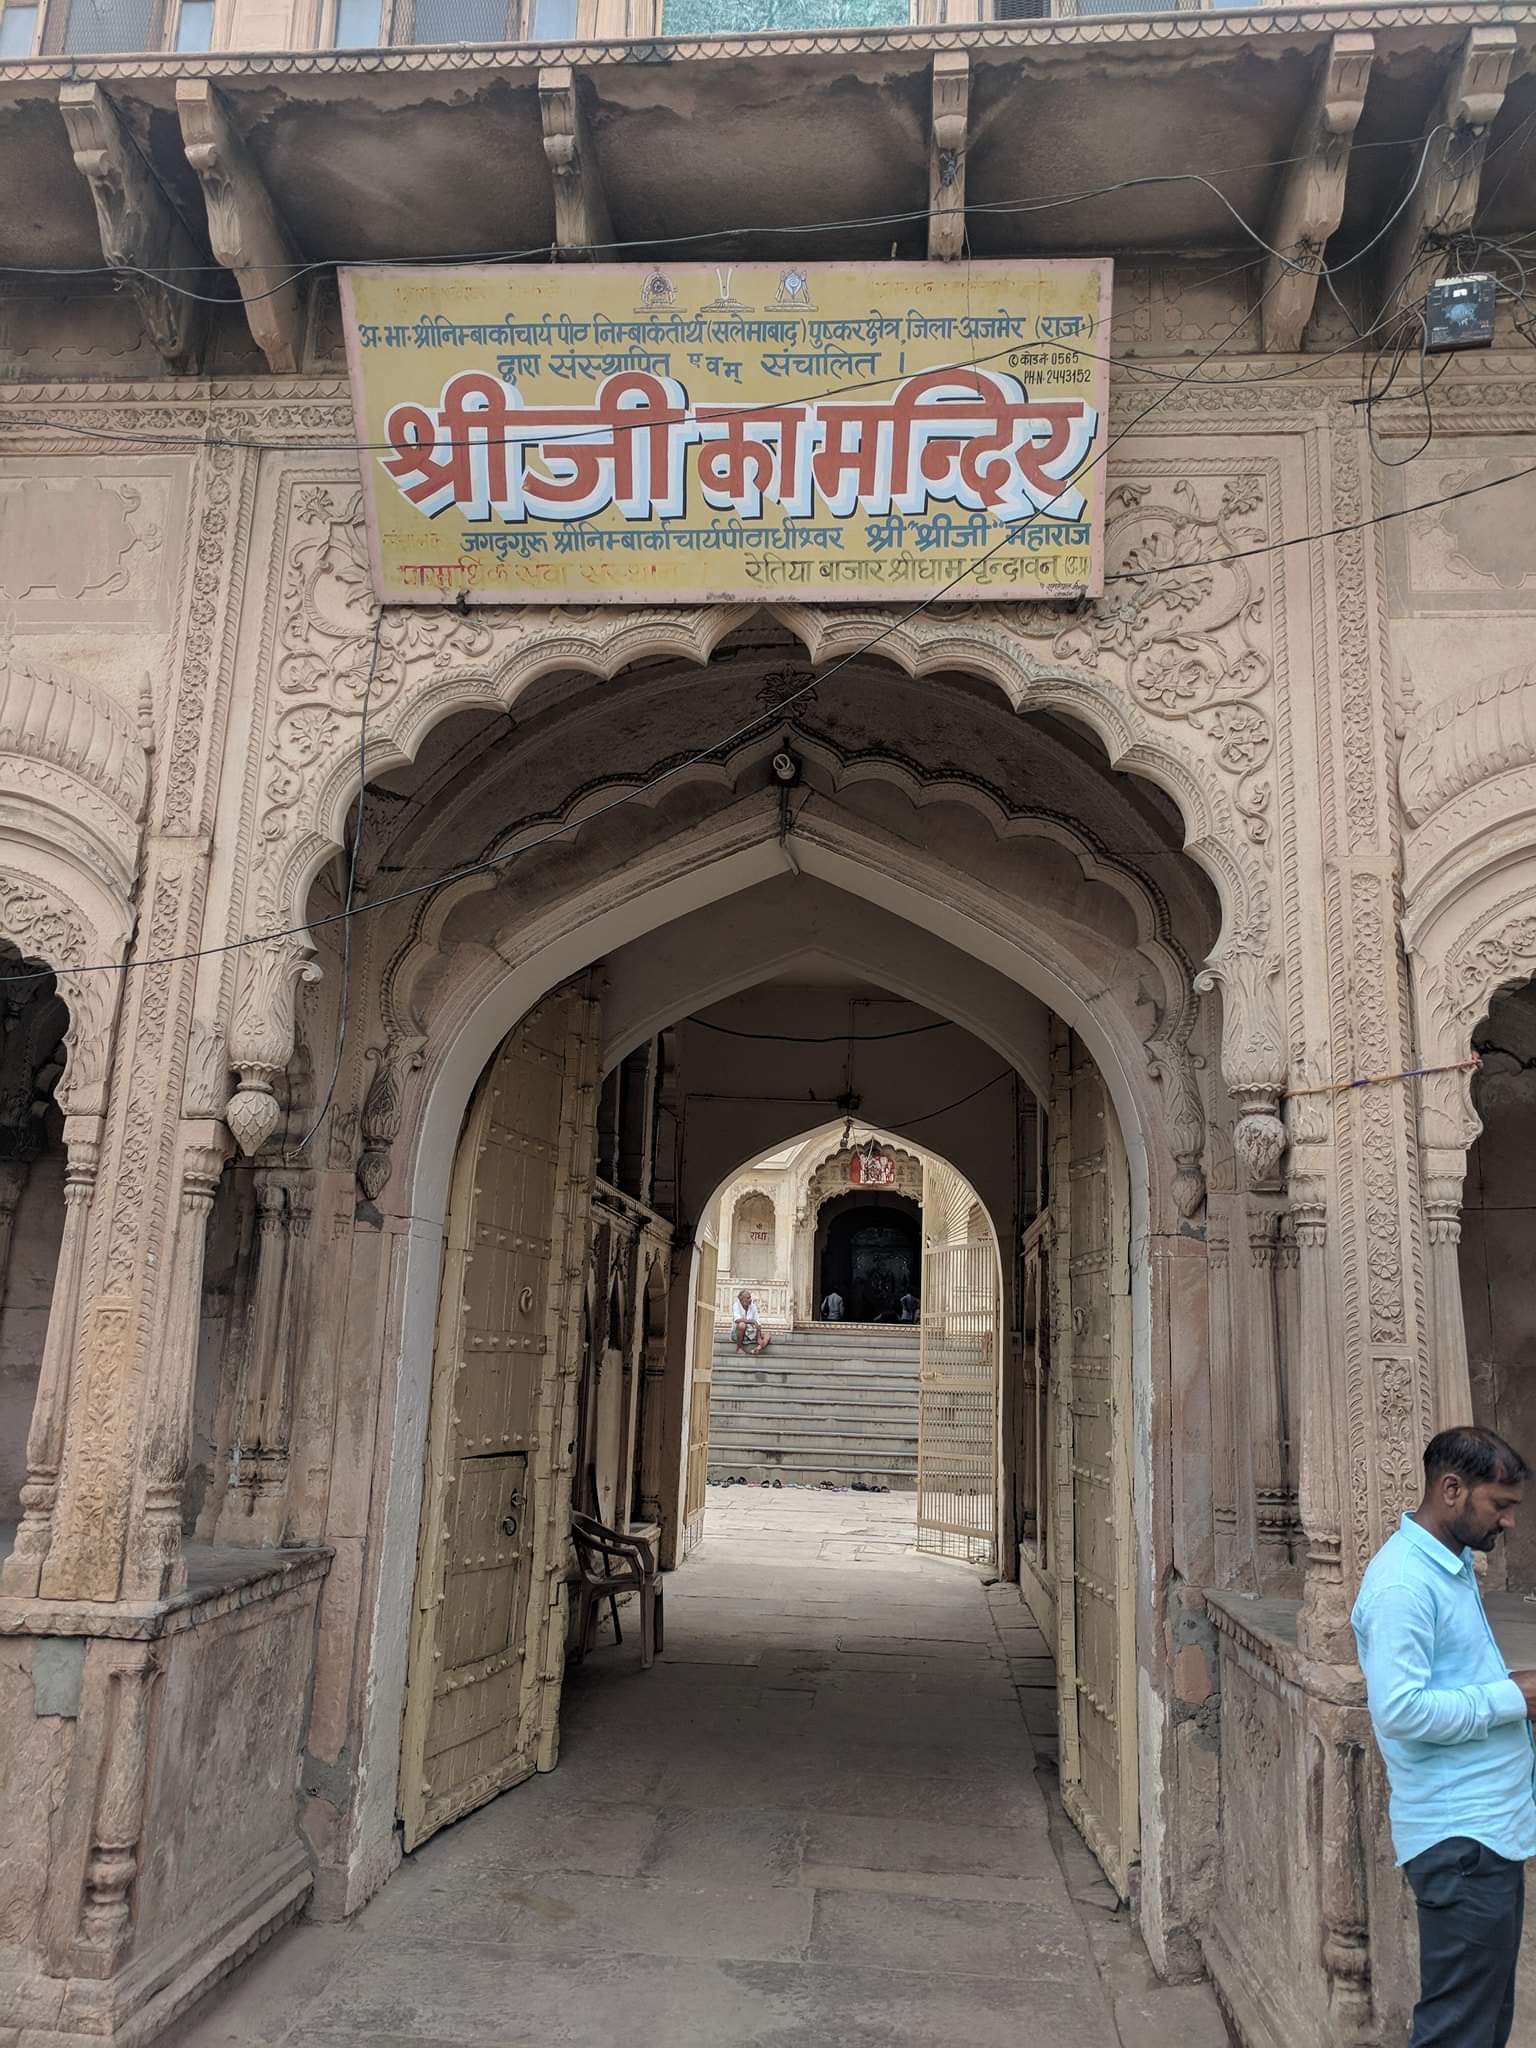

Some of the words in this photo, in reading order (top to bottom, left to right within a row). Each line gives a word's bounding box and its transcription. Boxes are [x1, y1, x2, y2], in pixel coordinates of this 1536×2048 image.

[556, 313, 591, 345] पीठ
[496, 353, 542, 386] द्वारा
[548, 344, 672, 381] संस्थापित
[761, 342, 882, 381] संचालित
[1051, 352, 1080, 366] 0565
[1047, 369, 1092, 385] 2443152
[376, 370, 691, 524] श्रीजी
[865, 514, 906, 553] श्री
[1005, 523, 1092, 551] महाराज
[744, 551, 814, 585] रेतिया
[818, 559, 887, 585] बाजार
[750, 1231, 768, 1241] राधा
